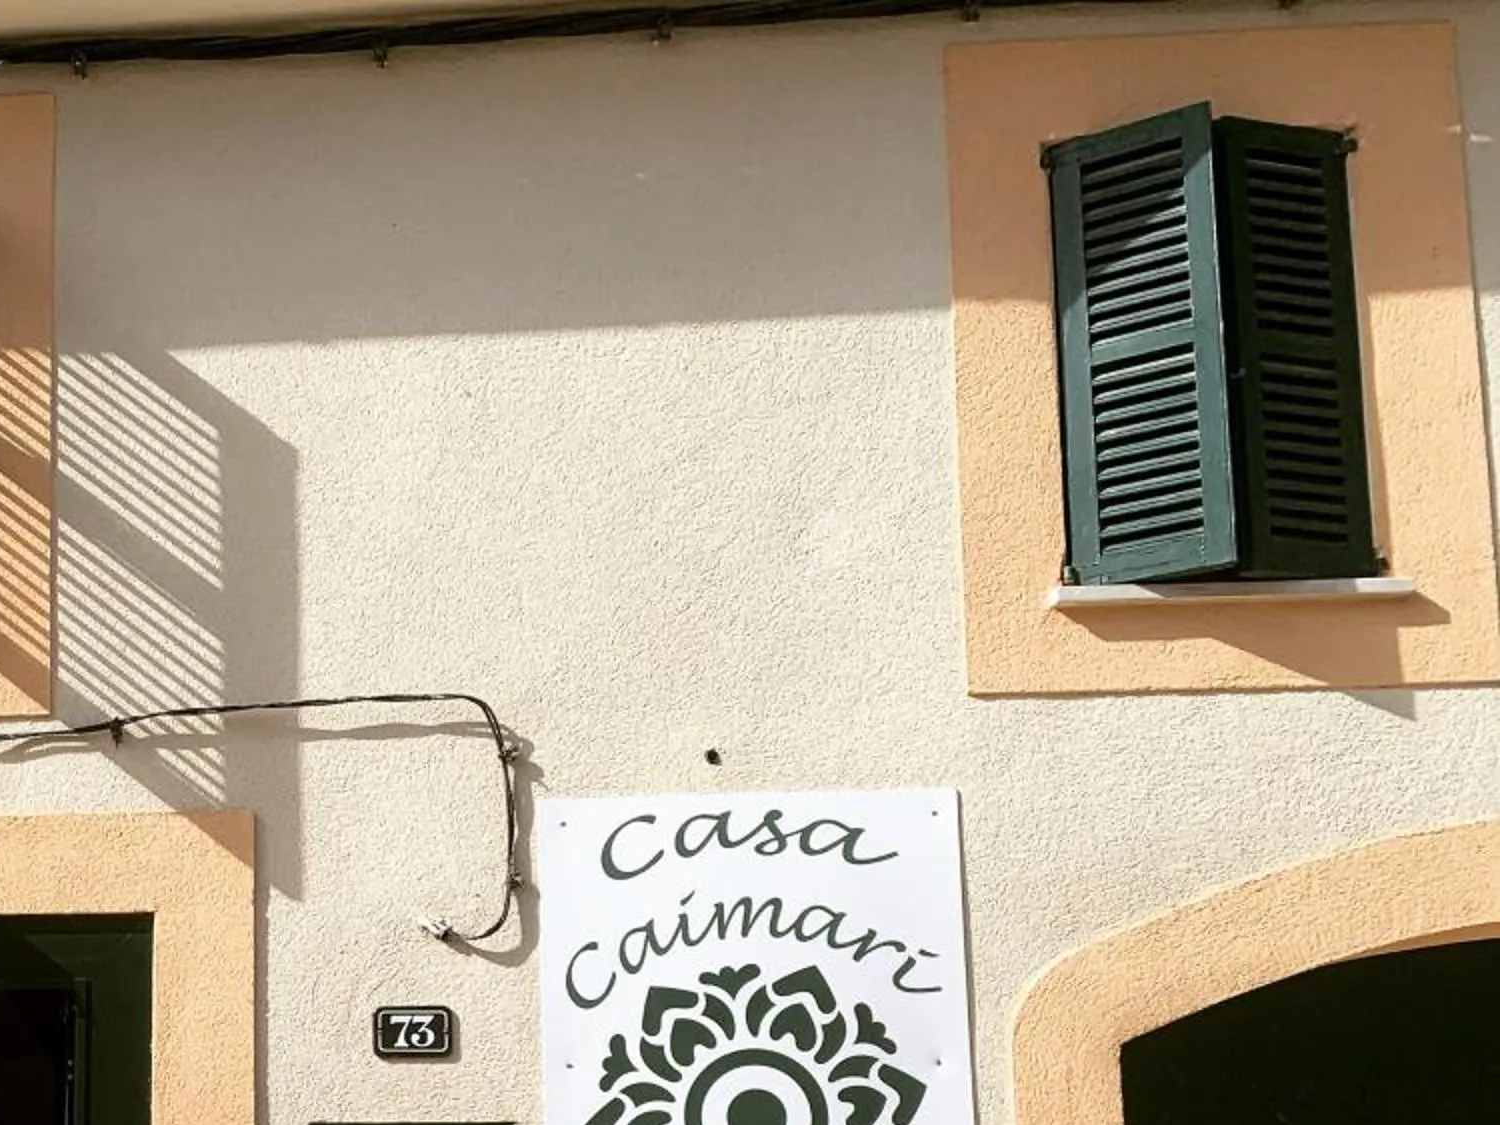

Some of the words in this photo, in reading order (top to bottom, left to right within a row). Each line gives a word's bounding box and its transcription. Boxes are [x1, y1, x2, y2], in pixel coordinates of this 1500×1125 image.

[600, 809, 899, 881] Casa
[565, 890, 943, 1009] Caimari
[389, 1014, 436, 1048] 73
